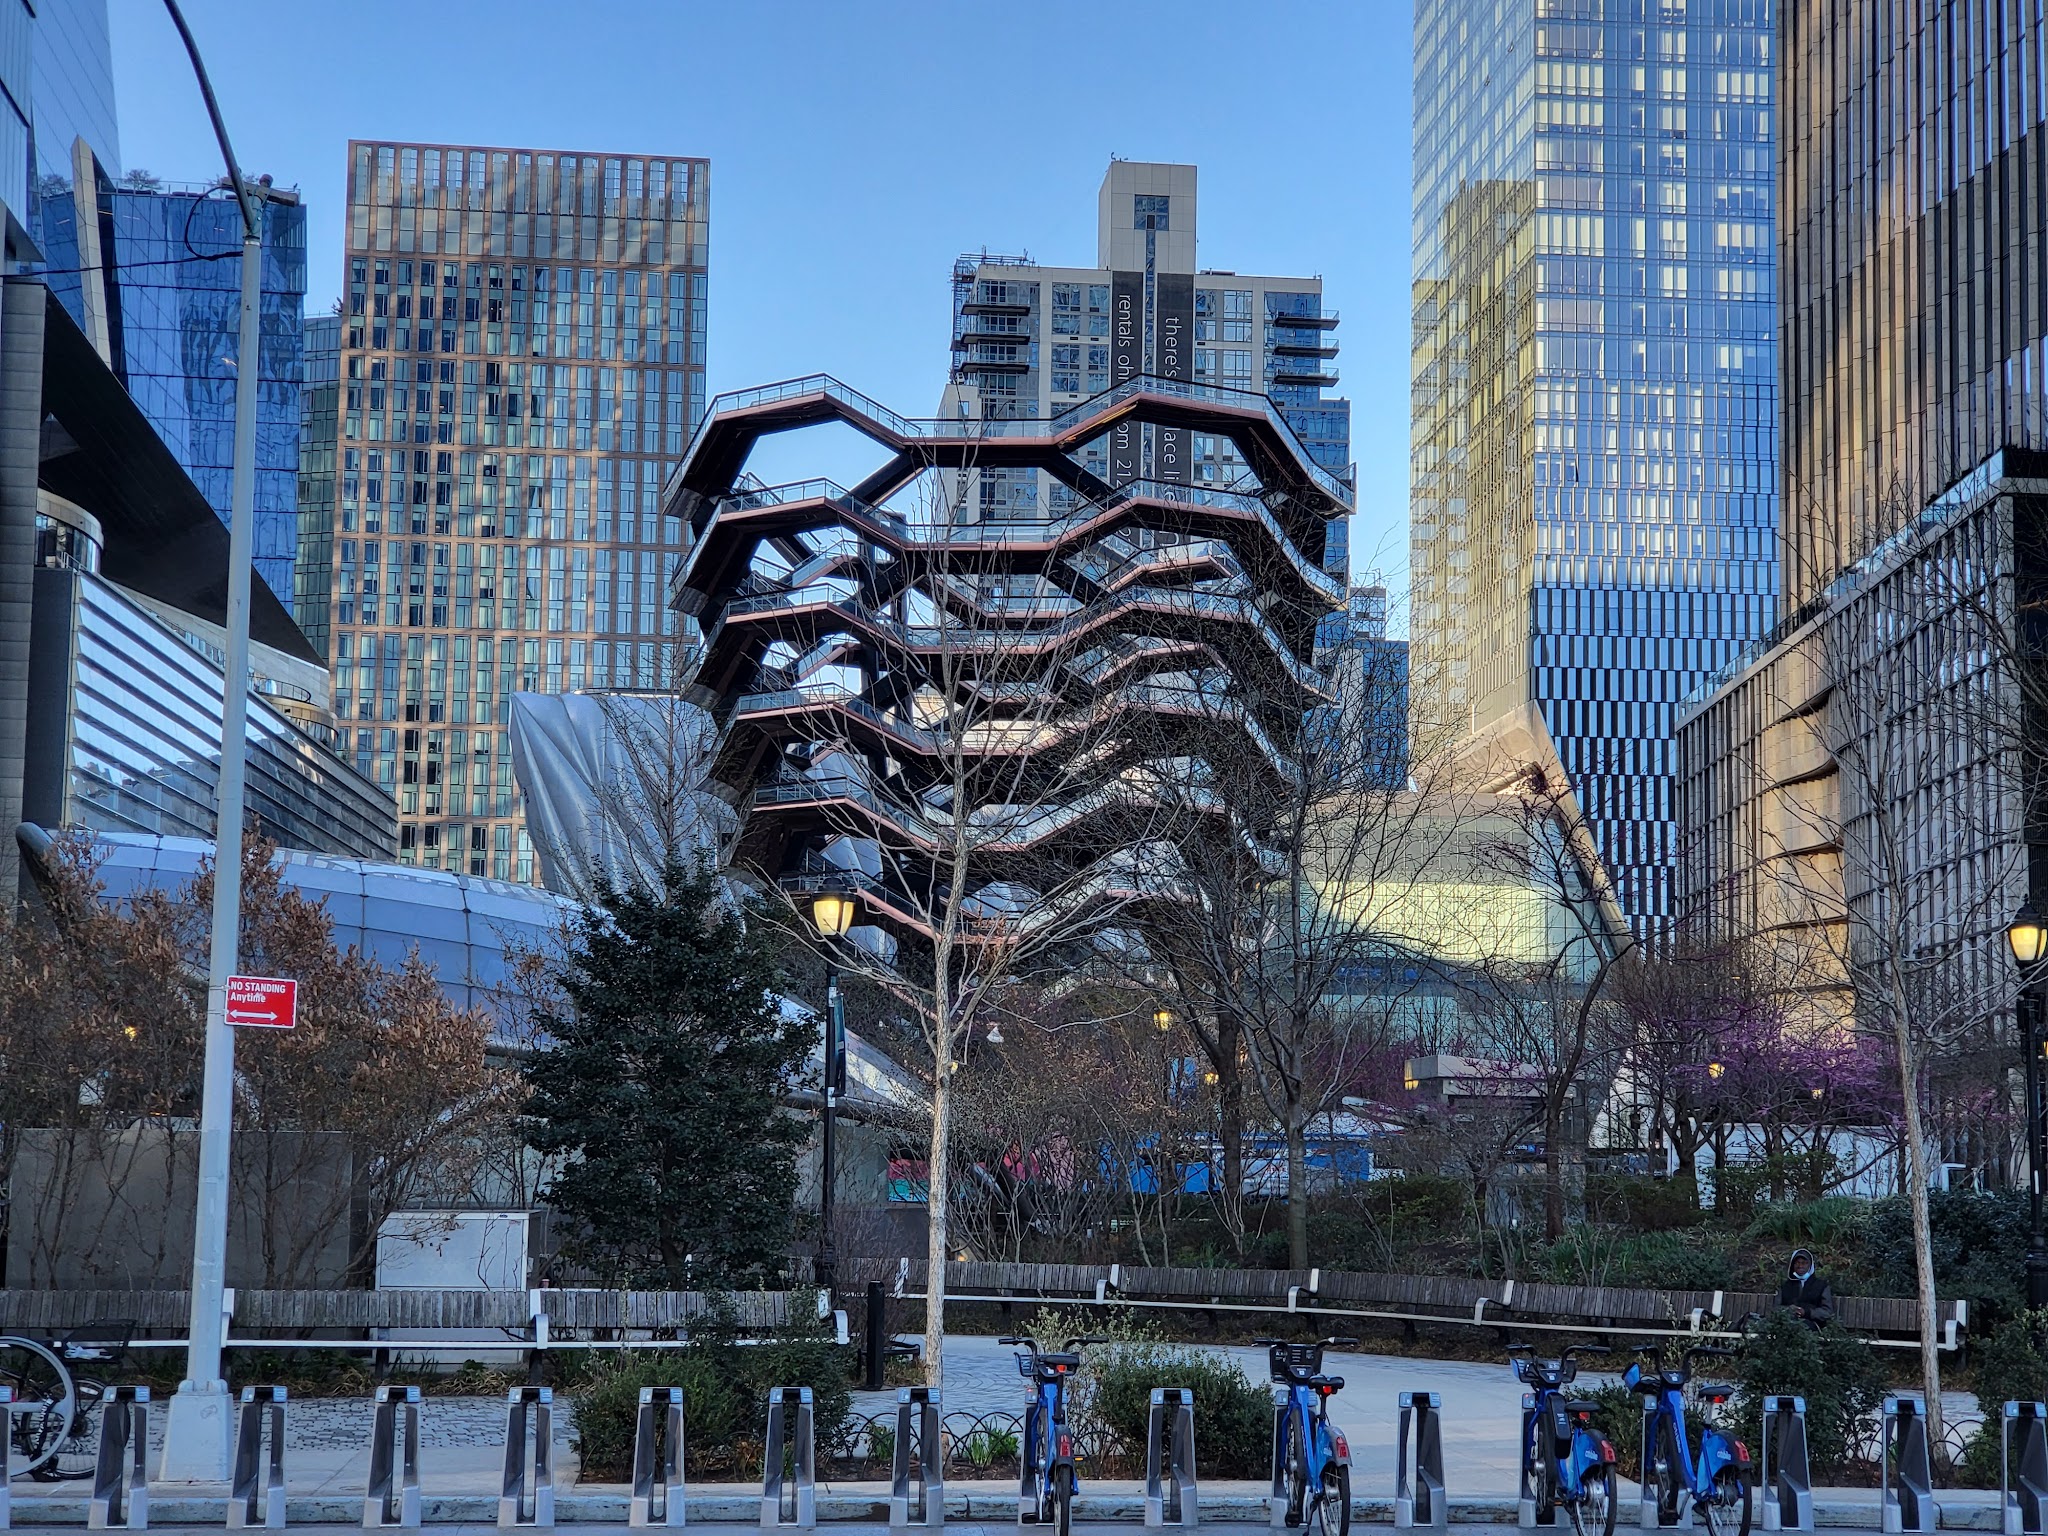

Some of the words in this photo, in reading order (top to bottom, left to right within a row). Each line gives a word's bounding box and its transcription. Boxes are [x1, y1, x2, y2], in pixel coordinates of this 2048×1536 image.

[1118, 294, 1135, 347] rentals
[1164, 316, 1182, 378] there's
[1163, 427, 1181, 464] lace
[230, 981, 243, 991] NO
[245, 982, 286, 994] STANDING
[230, 992, 266, 1003] Anytime
